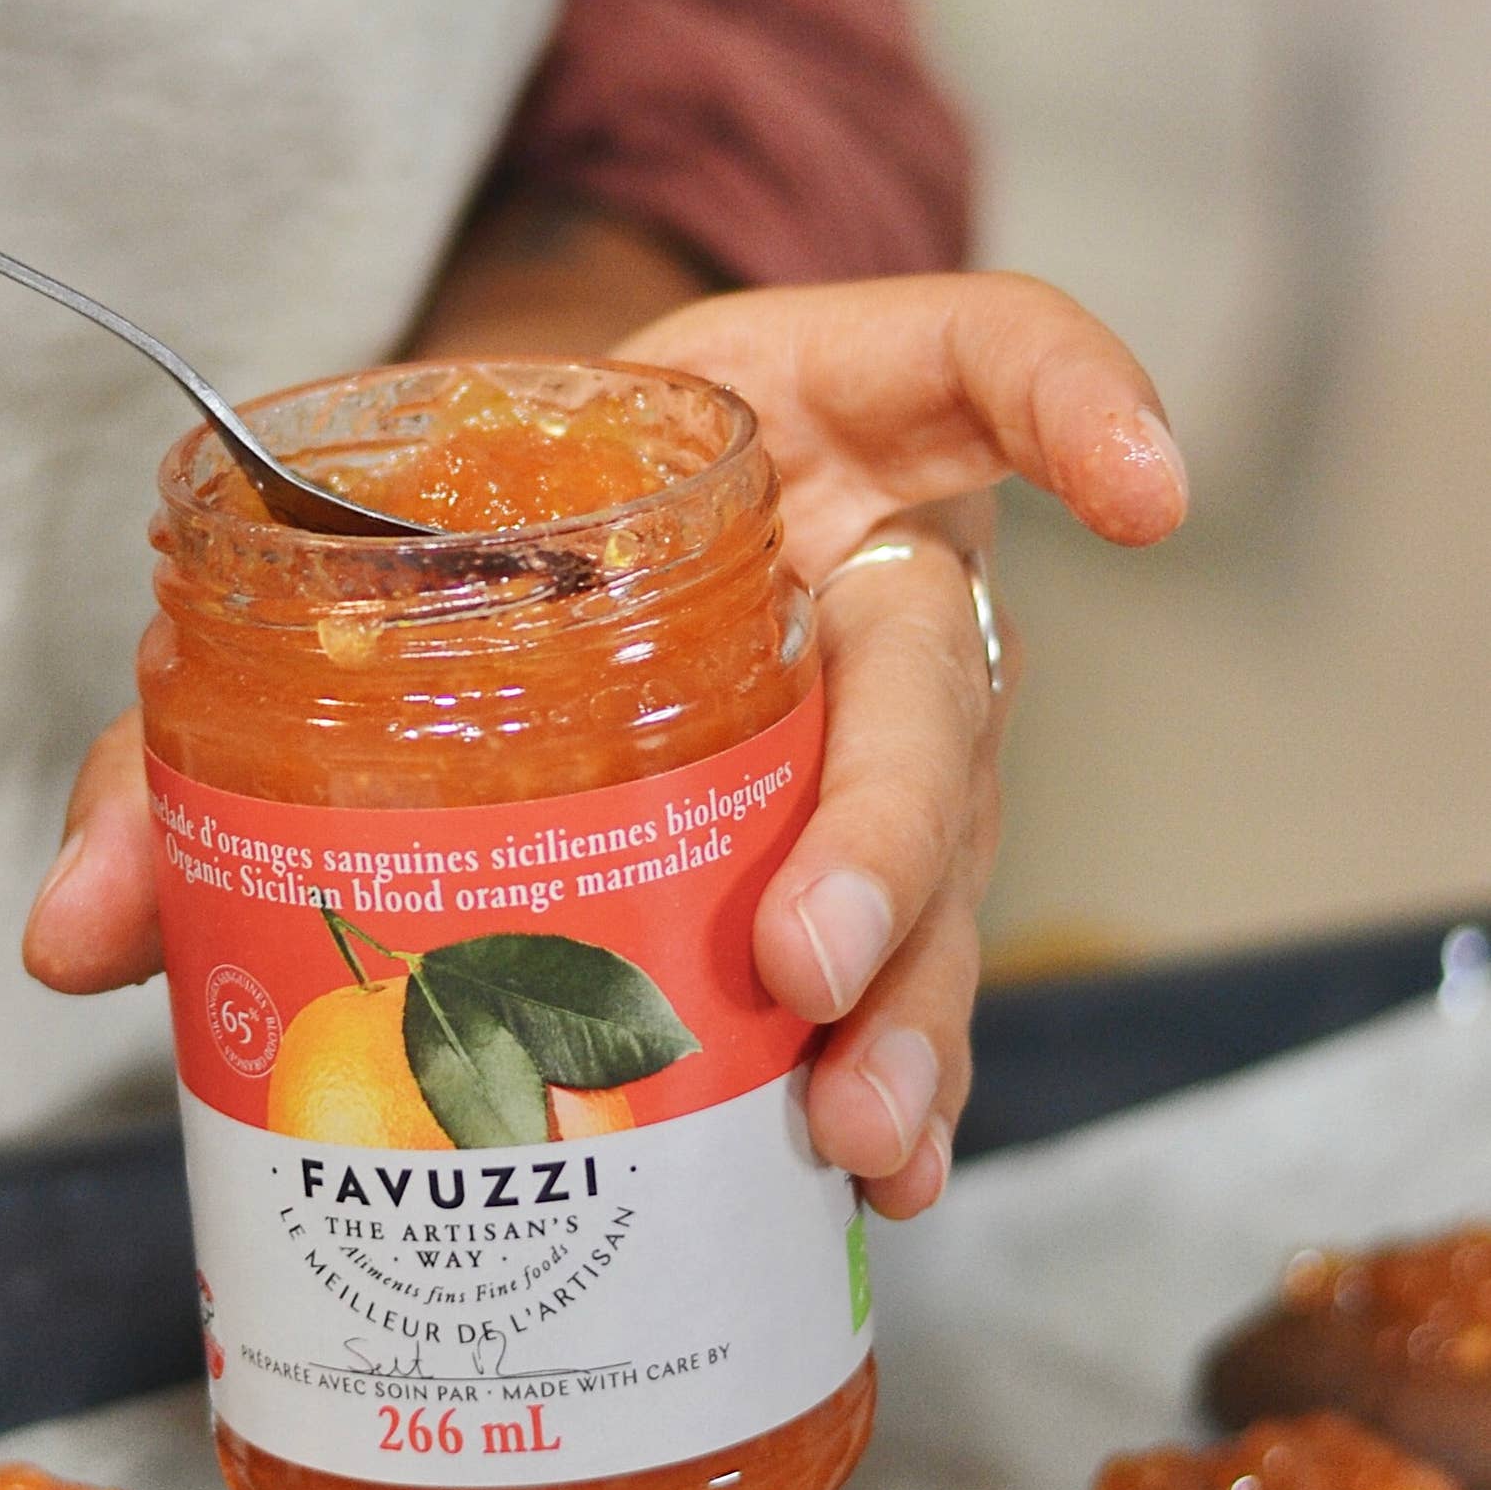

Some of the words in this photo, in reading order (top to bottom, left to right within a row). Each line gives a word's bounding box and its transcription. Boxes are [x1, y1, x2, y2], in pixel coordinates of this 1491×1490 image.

[200, 815, 313, 878] d'oranges
[323, 840, 479, 884] sanguines
[490, 819, 657, 870] siciliennes
[665, 760, 794, 837] biologiques
[166, 831, 234, 891] Organic
[239, 864, 343, 910] Sicilian
[351, 878, 445, 913] blood
[455, 878, 565, 914] orange
[576, 827, 732, 897] marmalade
[301, 1156, 598, 1209] FAVUZZI
[325, 1216, 385, 1240] THE
[402, 1215, 579, 1242] ARTISAN'S
[280, 1206, 307, 1241] LE
[304, 1248, 441, 1343] MEILLEUR
[457, 1320, 498, 1344] DE
[509, 1206, 636, 1333] L'ARTISAN
[339, 1245, 420, 1298] Aliments
[423, 1285, 466, 1305] fins
[476, 1278, 517, 1302] Fine
[523, 1243, 569, 1290] foods
[416, 1250, 483, 1268] WAY
[240, 1343, 313, 1385] PRÉPARÉE
[318, 1375, 367, 1396] AVEC
[374, 1382, 428, 1401] SOIN
[437, 1385, 478, 1402] PAR
[502, 1377, 570, 1400] MADE
[577, 1368, 638, 1393] WITH
[646, 1352, 700, 1381] CARE
[708, 1342, 731, 1365] BY
[377, 1404, 464, 1455] 266
[480, 1403, 562, 1454] mL
